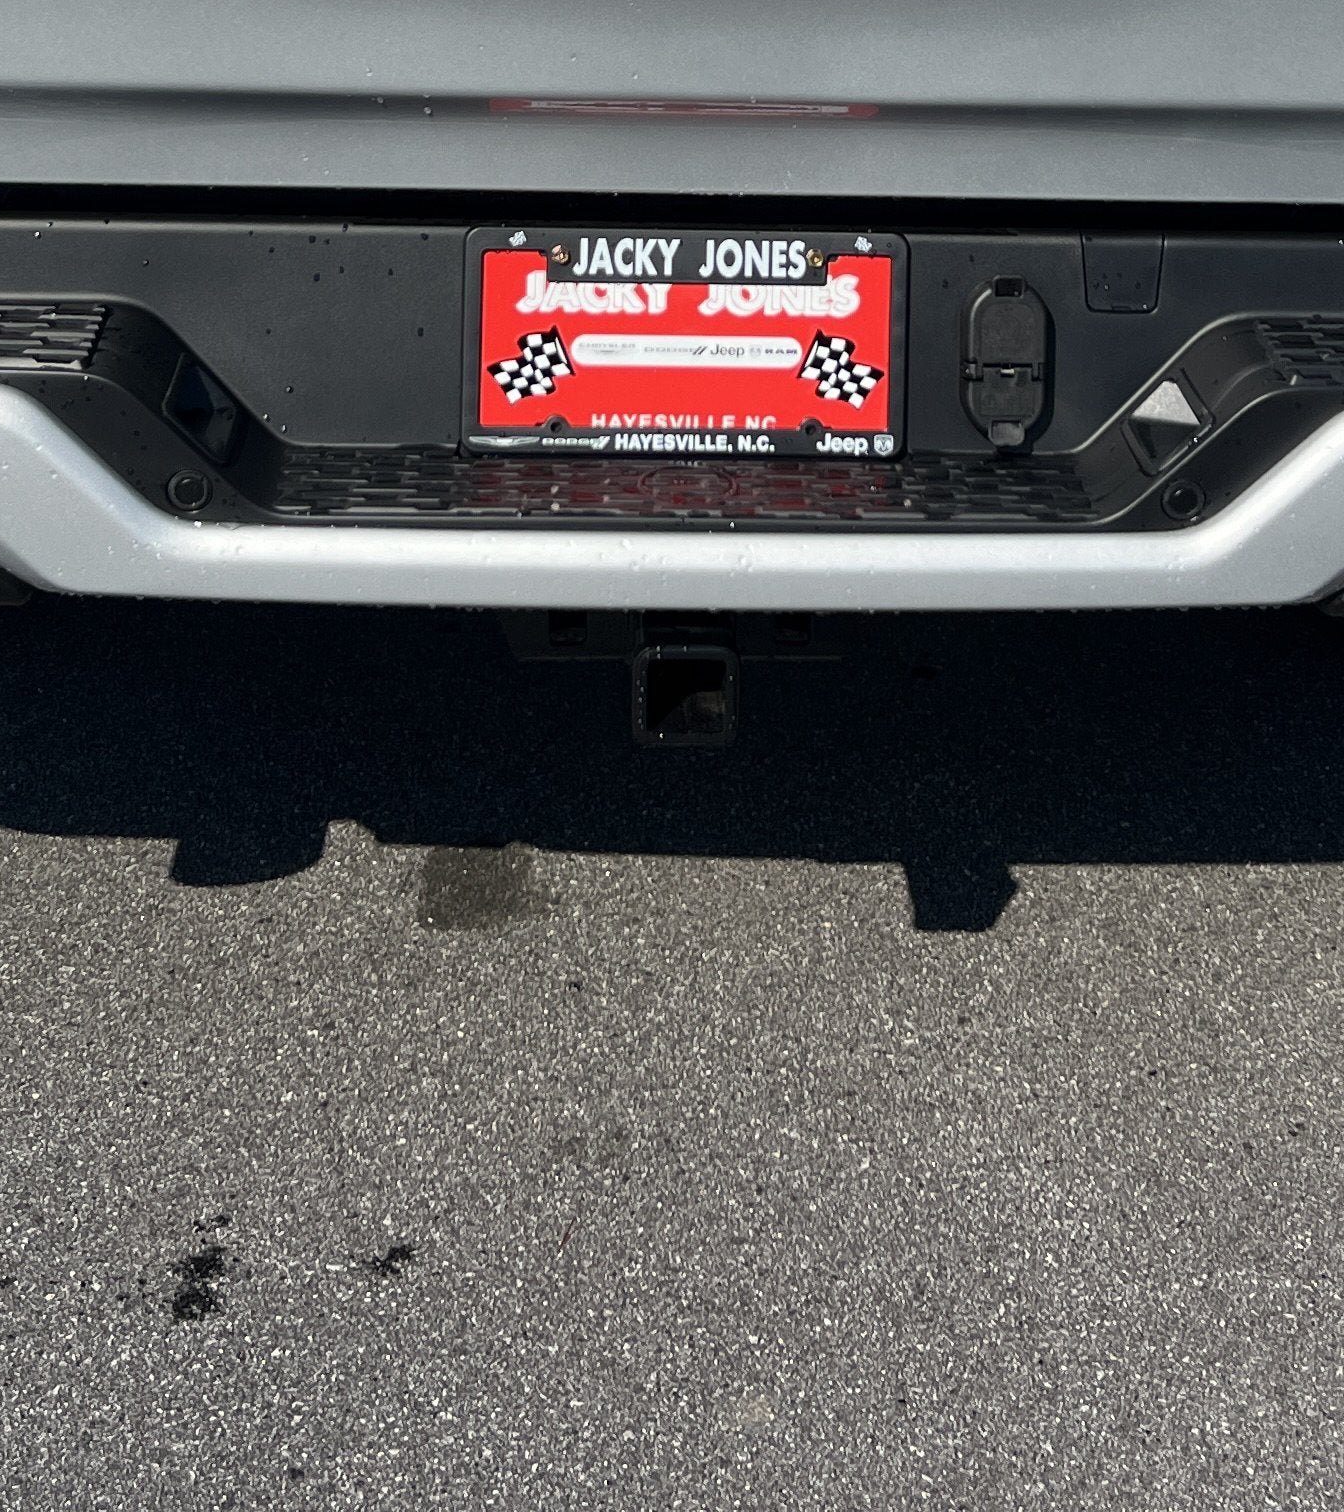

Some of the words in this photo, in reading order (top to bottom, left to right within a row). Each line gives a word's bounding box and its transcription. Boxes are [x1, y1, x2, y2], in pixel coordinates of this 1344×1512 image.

[573, 238, 680, 276] JACKY
[699, 239, 806, 279] JONES
[516, 270, 672, 314] JACKY
[698, 274, 860, 317] JONES
[710, 343, 745, 358] Jeep
[614, 434, 733, 452] HAYESVILLE,
[737, 435, 775, 452] N.C.
[816, 433, 869, 455] Jeep
